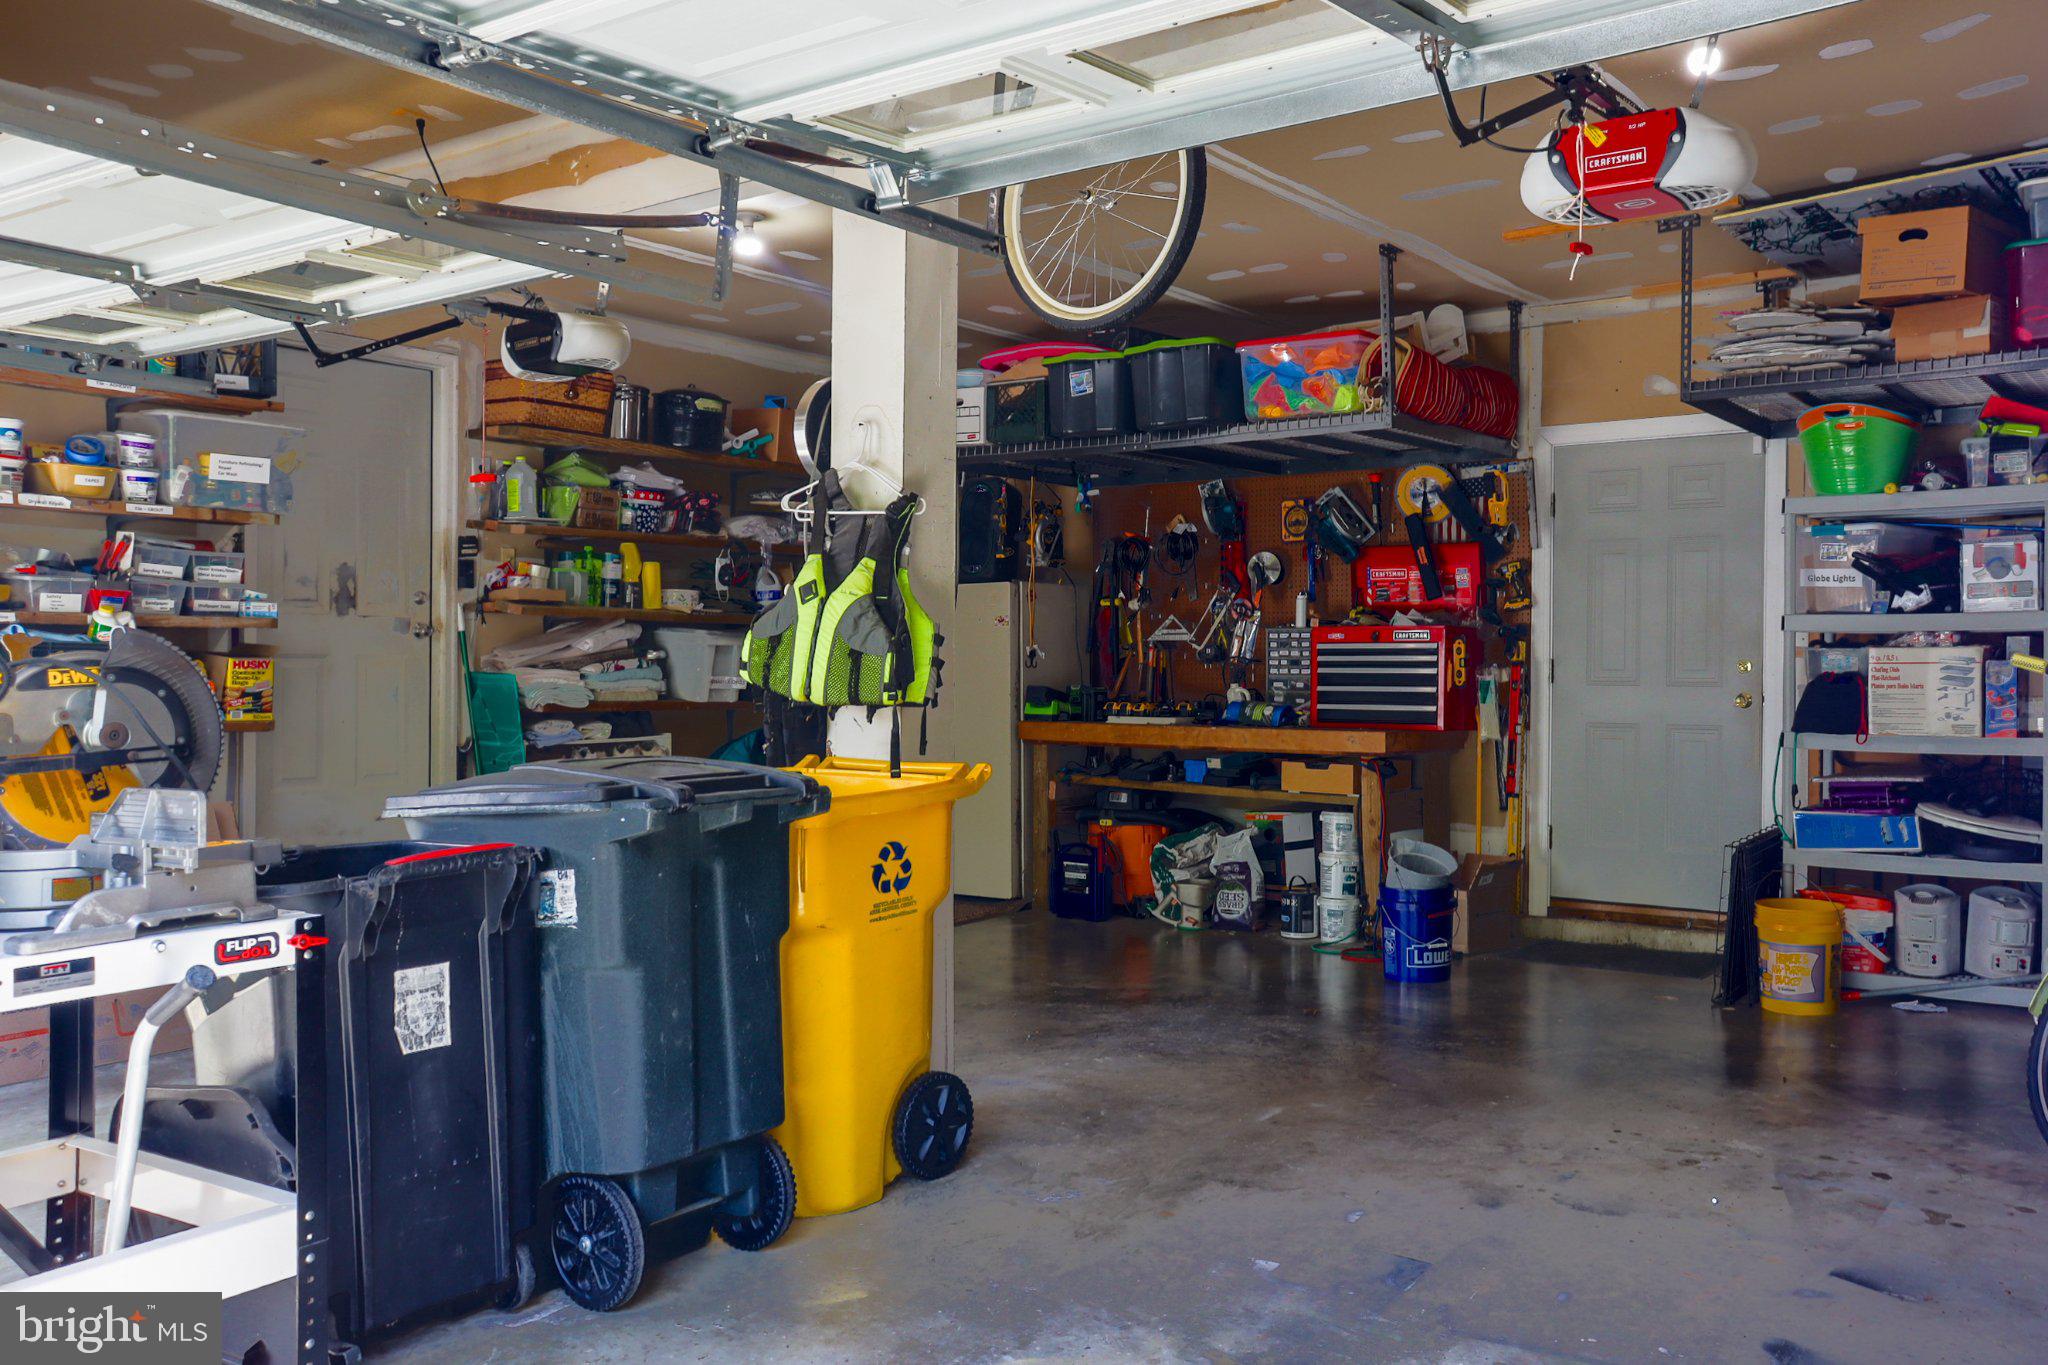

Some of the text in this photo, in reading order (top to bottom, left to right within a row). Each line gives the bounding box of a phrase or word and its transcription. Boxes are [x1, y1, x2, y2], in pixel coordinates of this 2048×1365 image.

[1589, 151, 1643, 169] CRAFTSMAN
[1807, 574, 1856, 583] Globe Lights
[233, 659, 271, 669] HUSKY
[1219, 891, 1245, 901] SEED
[1218, 900, 1244, 909] GRASS
[226, 937, 257, 952] FLIP
[242, 945, 271, 959] TOP
[1413, 949, 1451, 965] LOWE
[43, 964, 69, 975] JET
